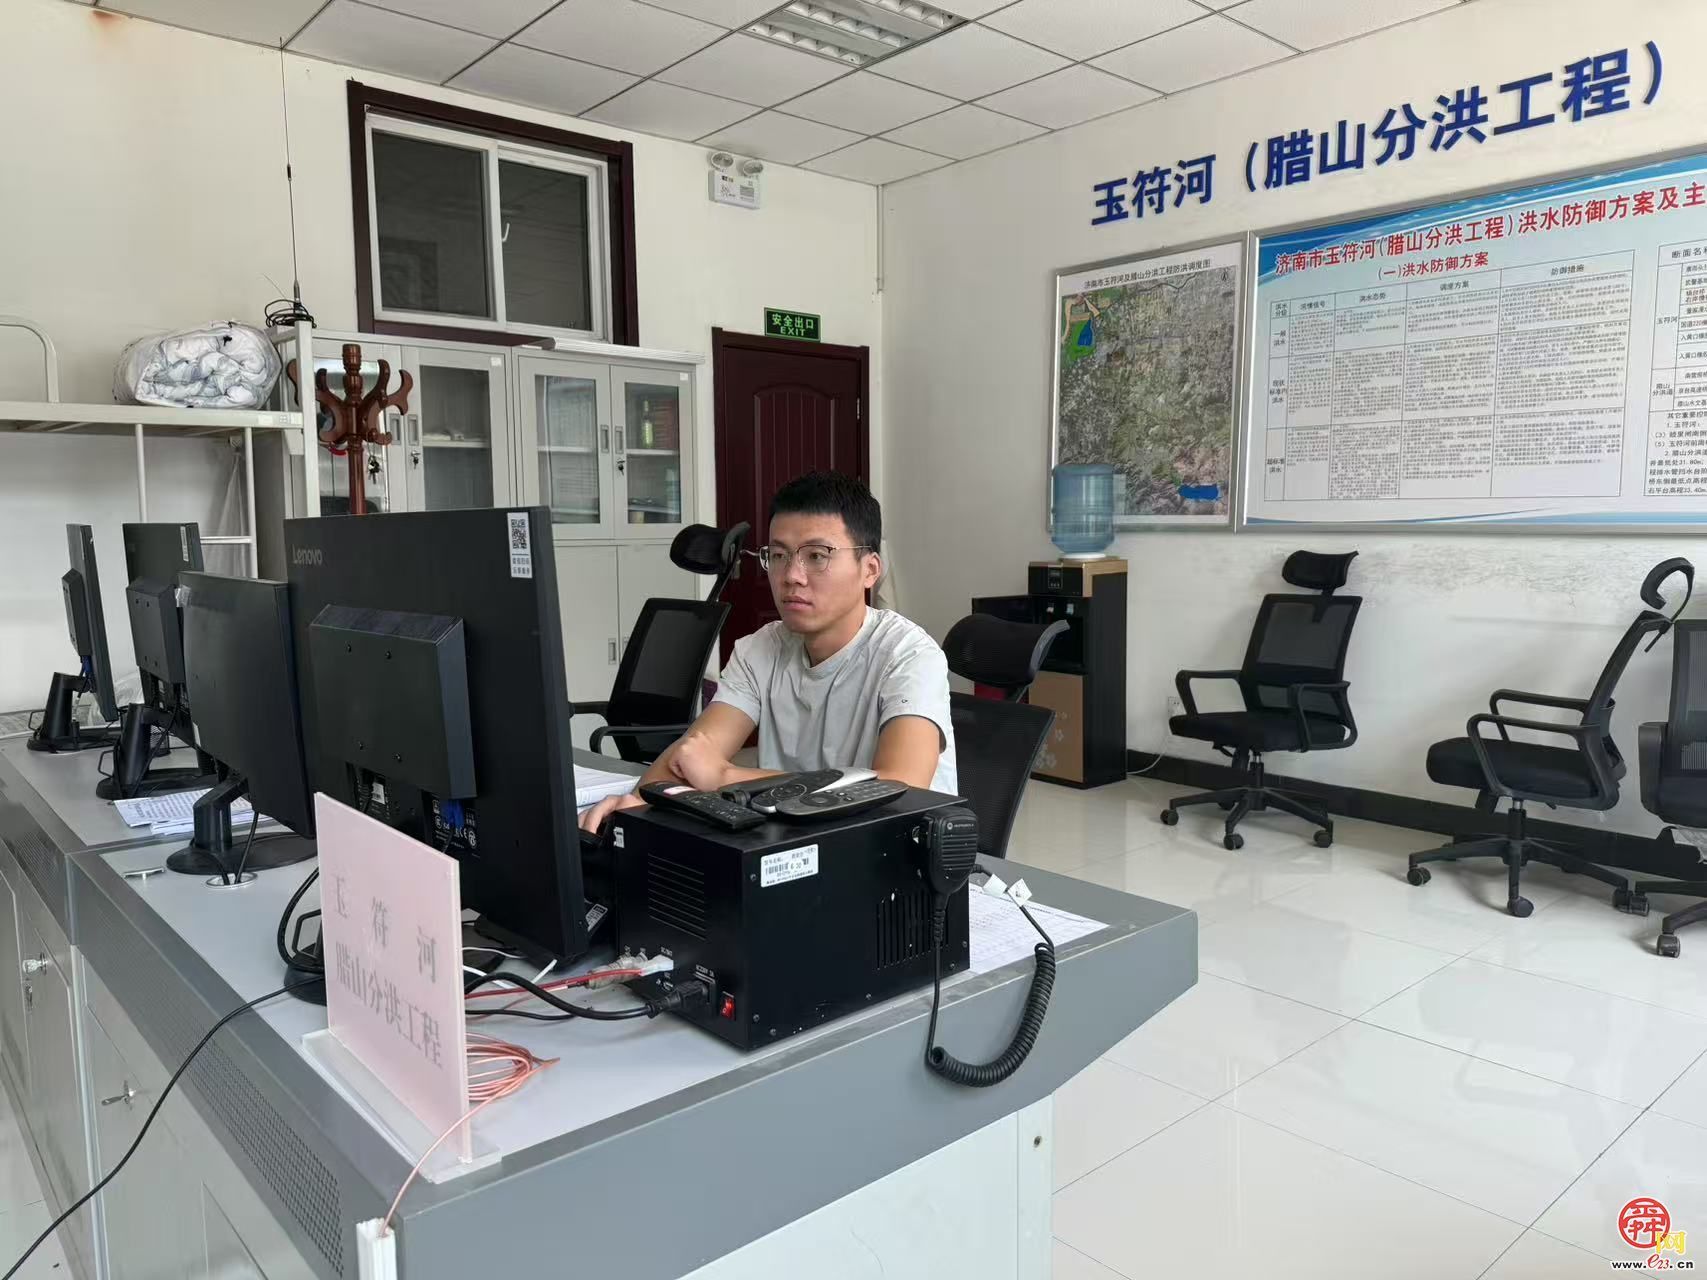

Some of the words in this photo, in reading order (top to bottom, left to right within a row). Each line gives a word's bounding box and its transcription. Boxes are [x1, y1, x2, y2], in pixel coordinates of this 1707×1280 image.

[1091, 40, 1664, 226] 玉符河（腊山分洪工程）
[771, 313, 814, 330] 安全出口
[780, 327, 806, 337] EXIT
[292, 546, 323, 566] Lenovo
[335, 940, 443, 1072] 腊山分洪工程
